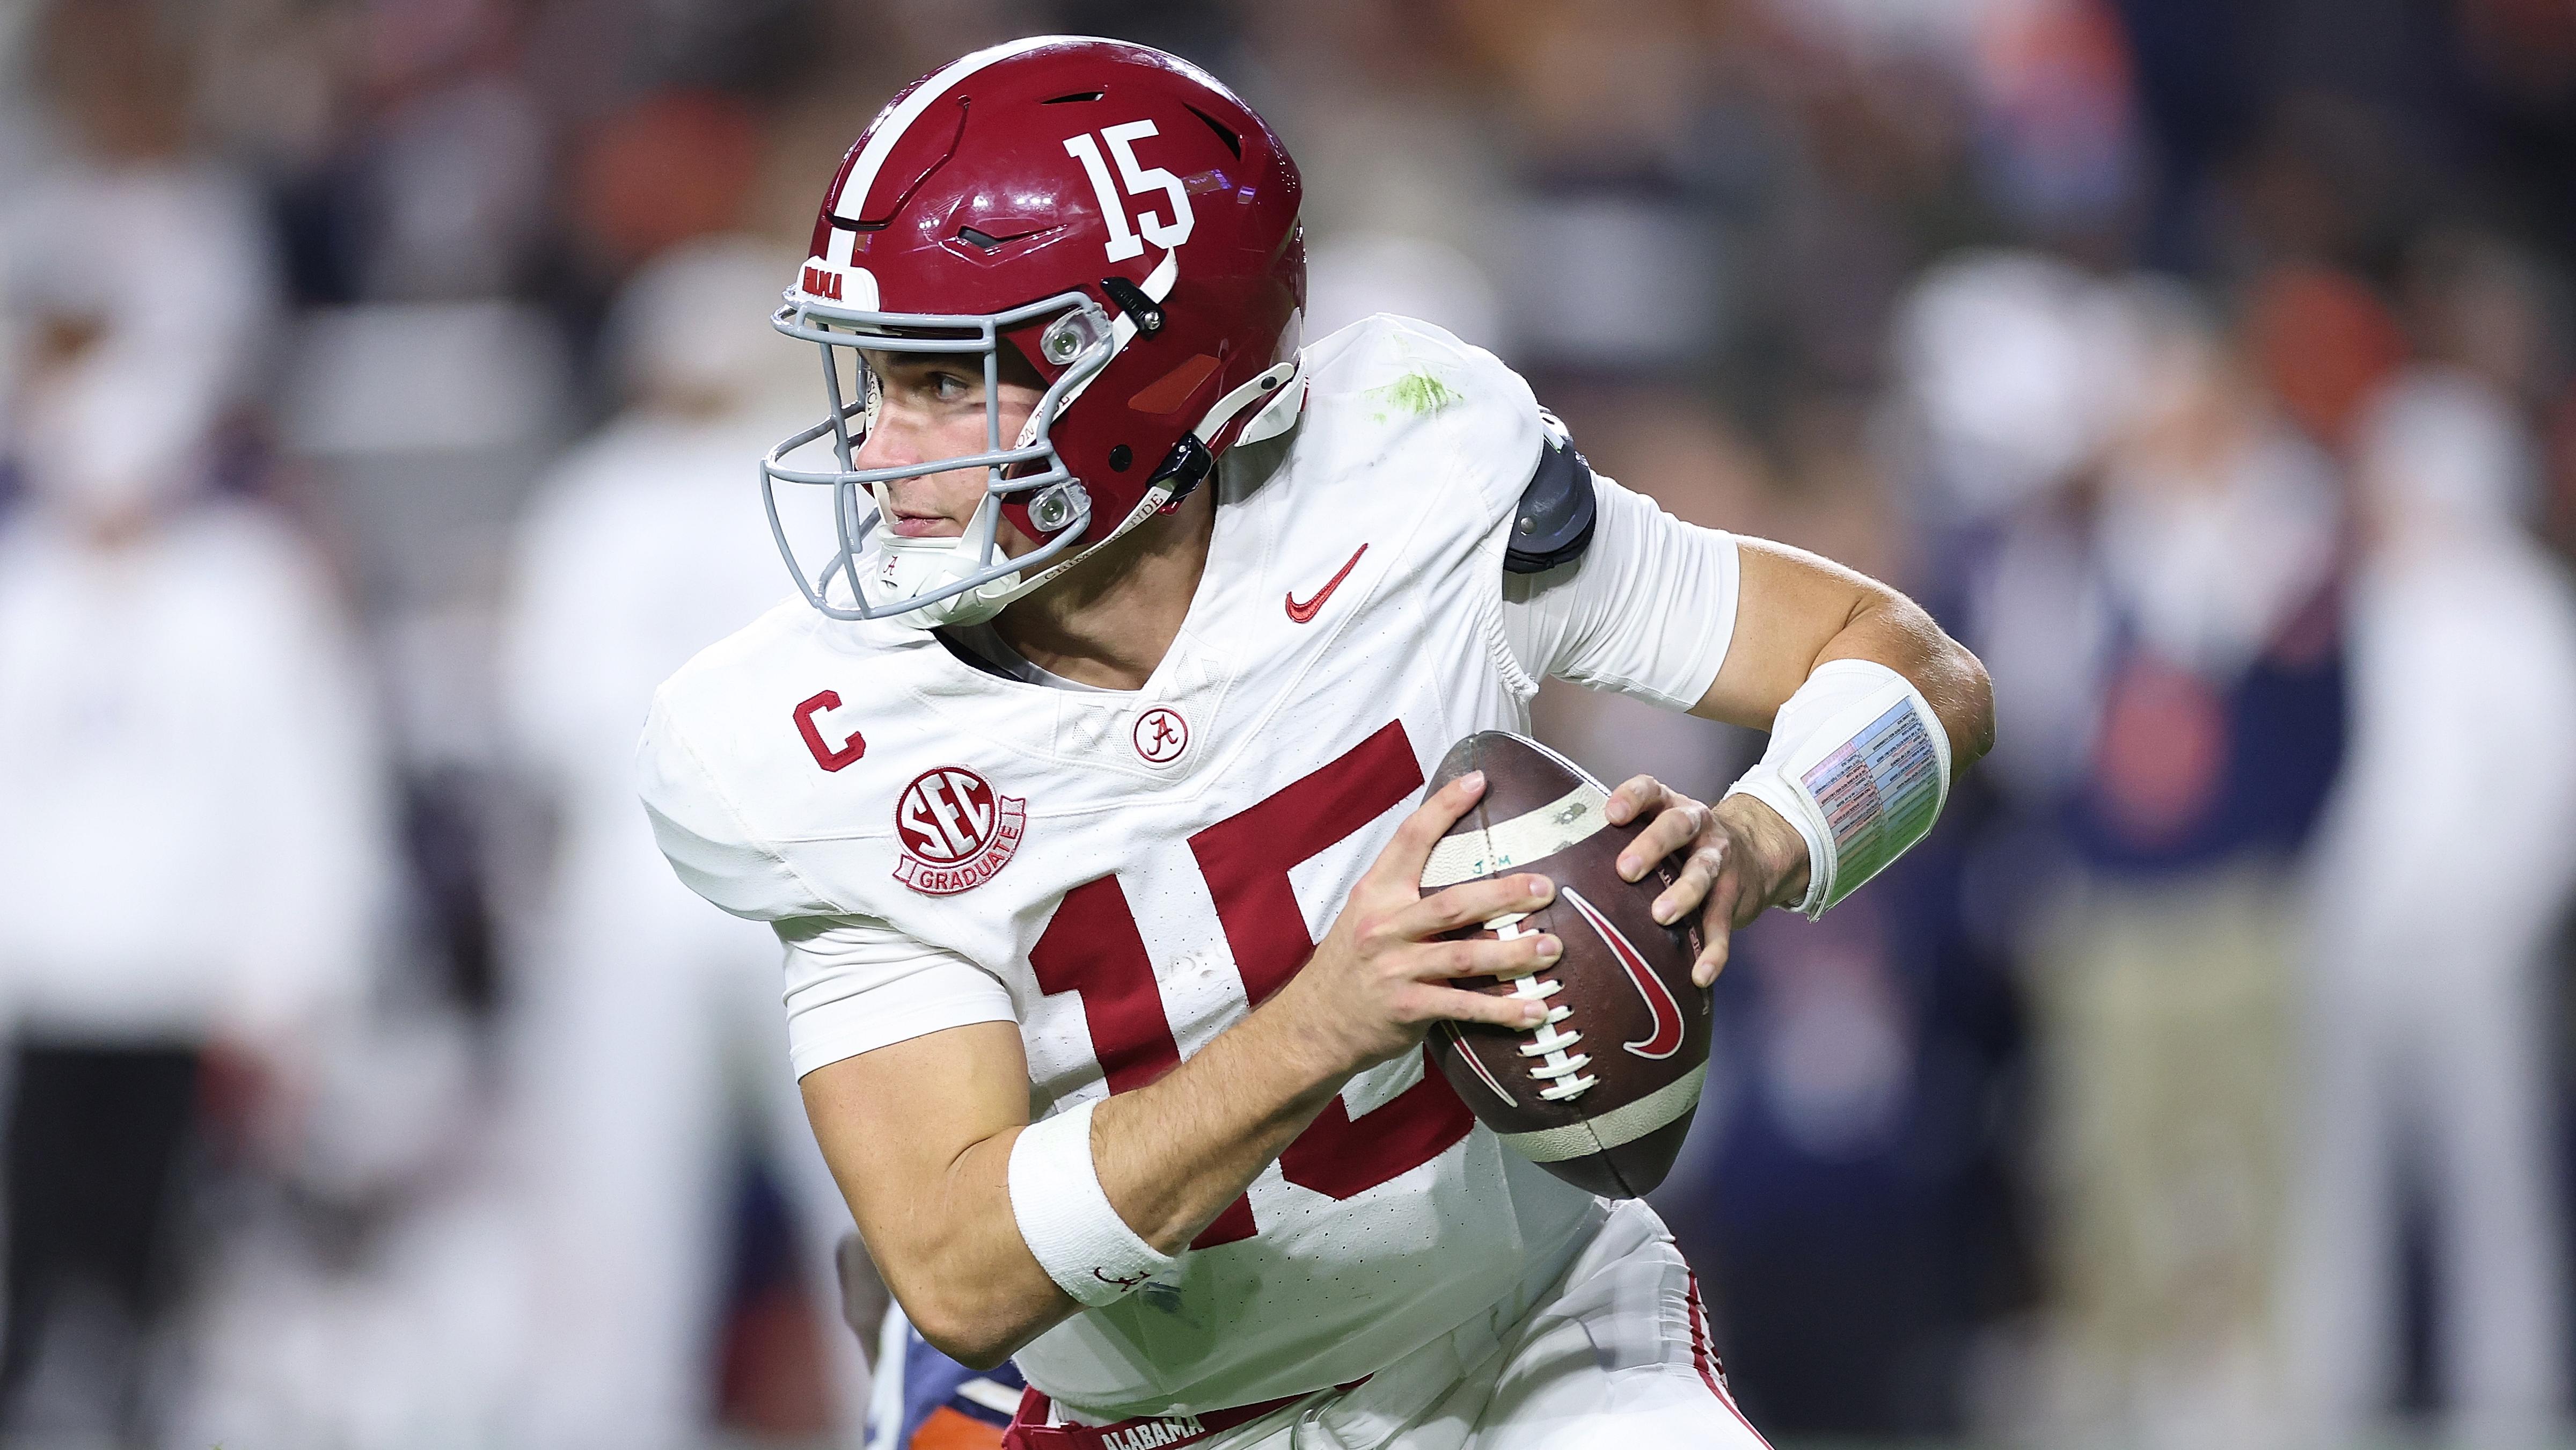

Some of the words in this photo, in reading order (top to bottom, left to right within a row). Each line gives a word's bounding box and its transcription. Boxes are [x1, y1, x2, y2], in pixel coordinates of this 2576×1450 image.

[1062, 119, 1195, 263] 15
[1127, 493, 1163, 527] TIDE
[883, 555, 898, 575] A
[793, 689, 866, 773] C
[1147, 713, 1179, 756] A
[901, 771, 991, 859] SEC
[920, 825, 1019, 890] GRADUATE
[1028, 718, 1476, 1251] 15
[1101, 1415, 1206, 1450] ALABAMA
